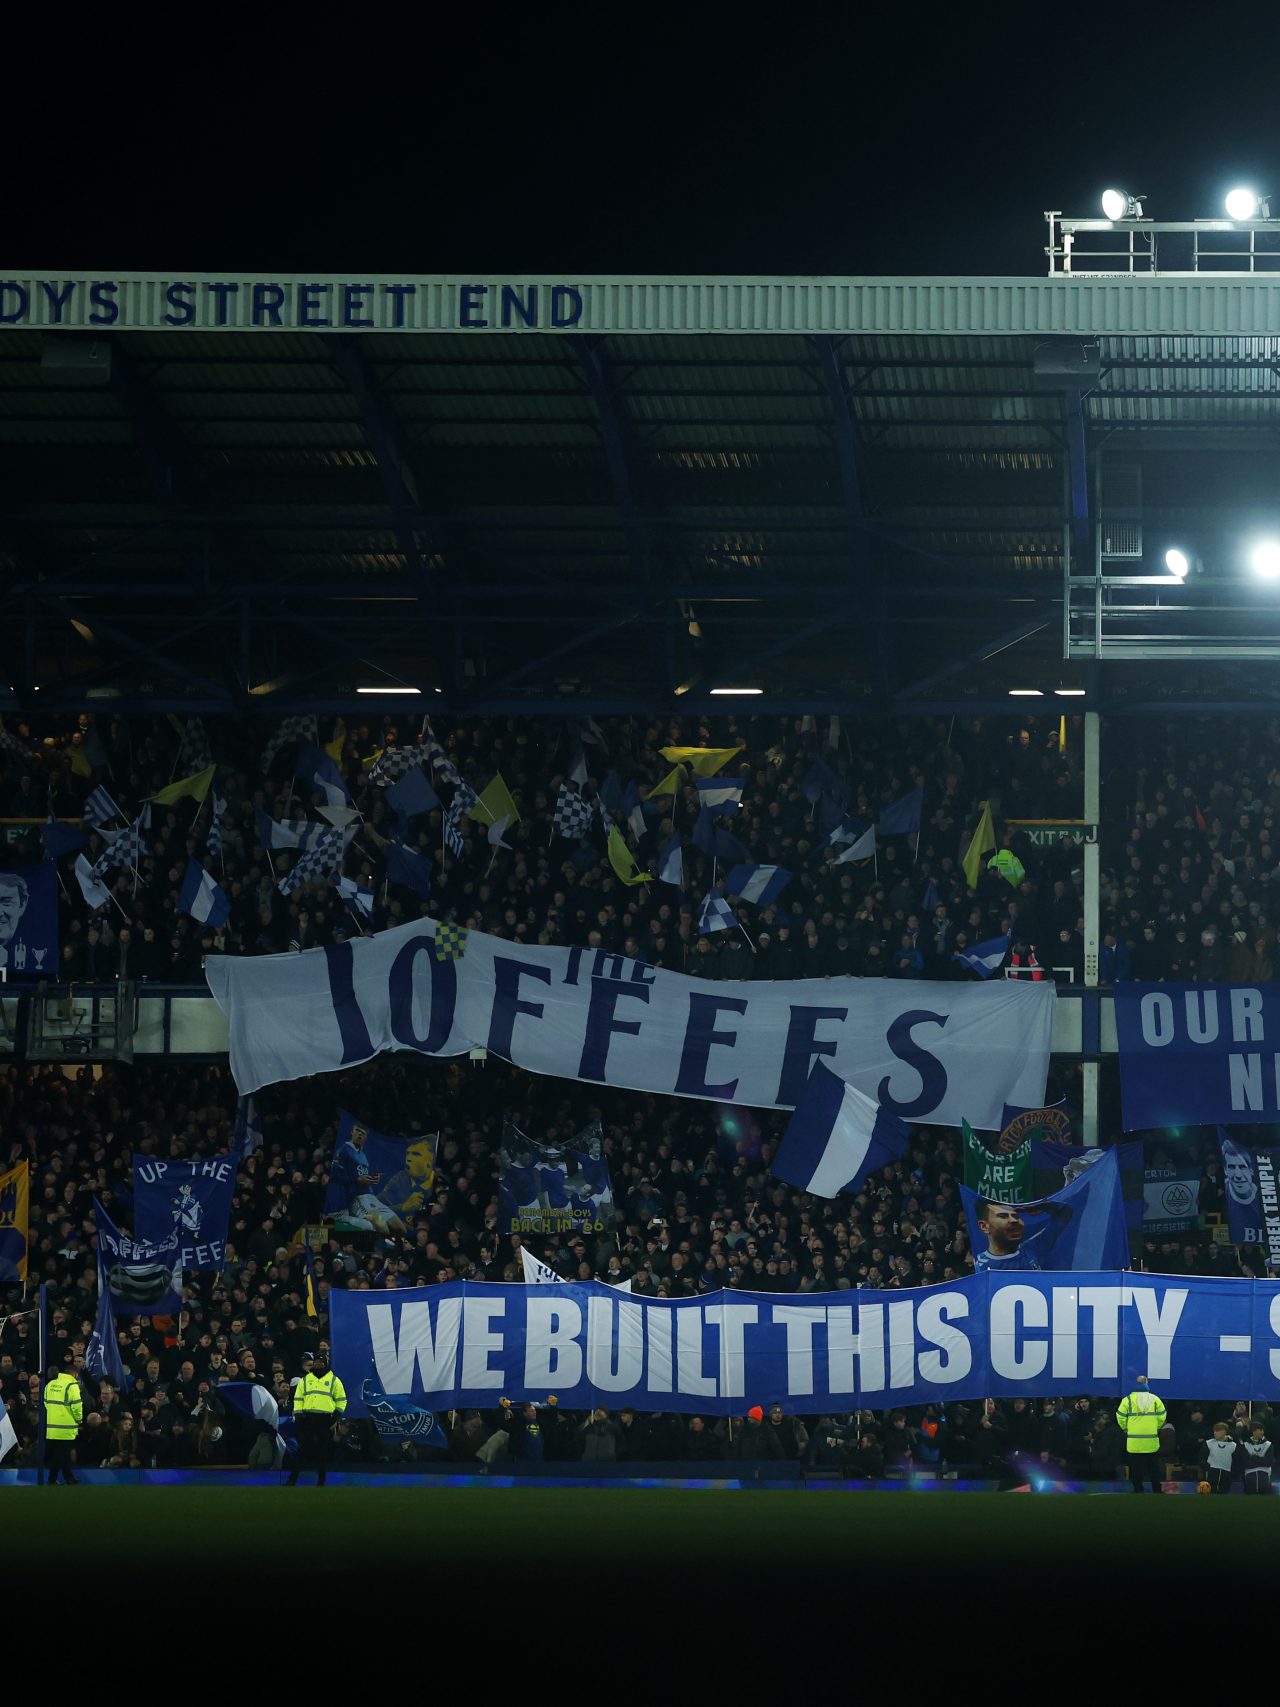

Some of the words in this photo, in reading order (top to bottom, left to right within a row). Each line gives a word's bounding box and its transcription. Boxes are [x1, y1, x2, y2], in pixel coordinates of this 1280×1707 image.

[0, 282, 119, 325] DYS
[165, 283, 416, 328] STREET
[459, 286, 583, 329] END
[1025, 830, 1056, 845] XIT
[1085, 826, 1097, 843] J
[1141, 988, 1264, 1047] OUR
[139, 1162, 168, 1184] UP
[187, 1161, 232, 1183] THE
[983, 1165, 1015, 1183] ARE
[1144, 1168, 1177, 1179] ERTON
[1256, 1154, 1279, 1214] TEMPLE
[977, 1181, 1024, 1204] MAGIC
[557, 1217, 573, 1233] IN
[366, 1296, 506, 1395] WE
[524, 1296, 759, 1398] BUILT
[772, 1291, 972, 1396] THIS
[990, 1284, 1188, 1380] CITY
